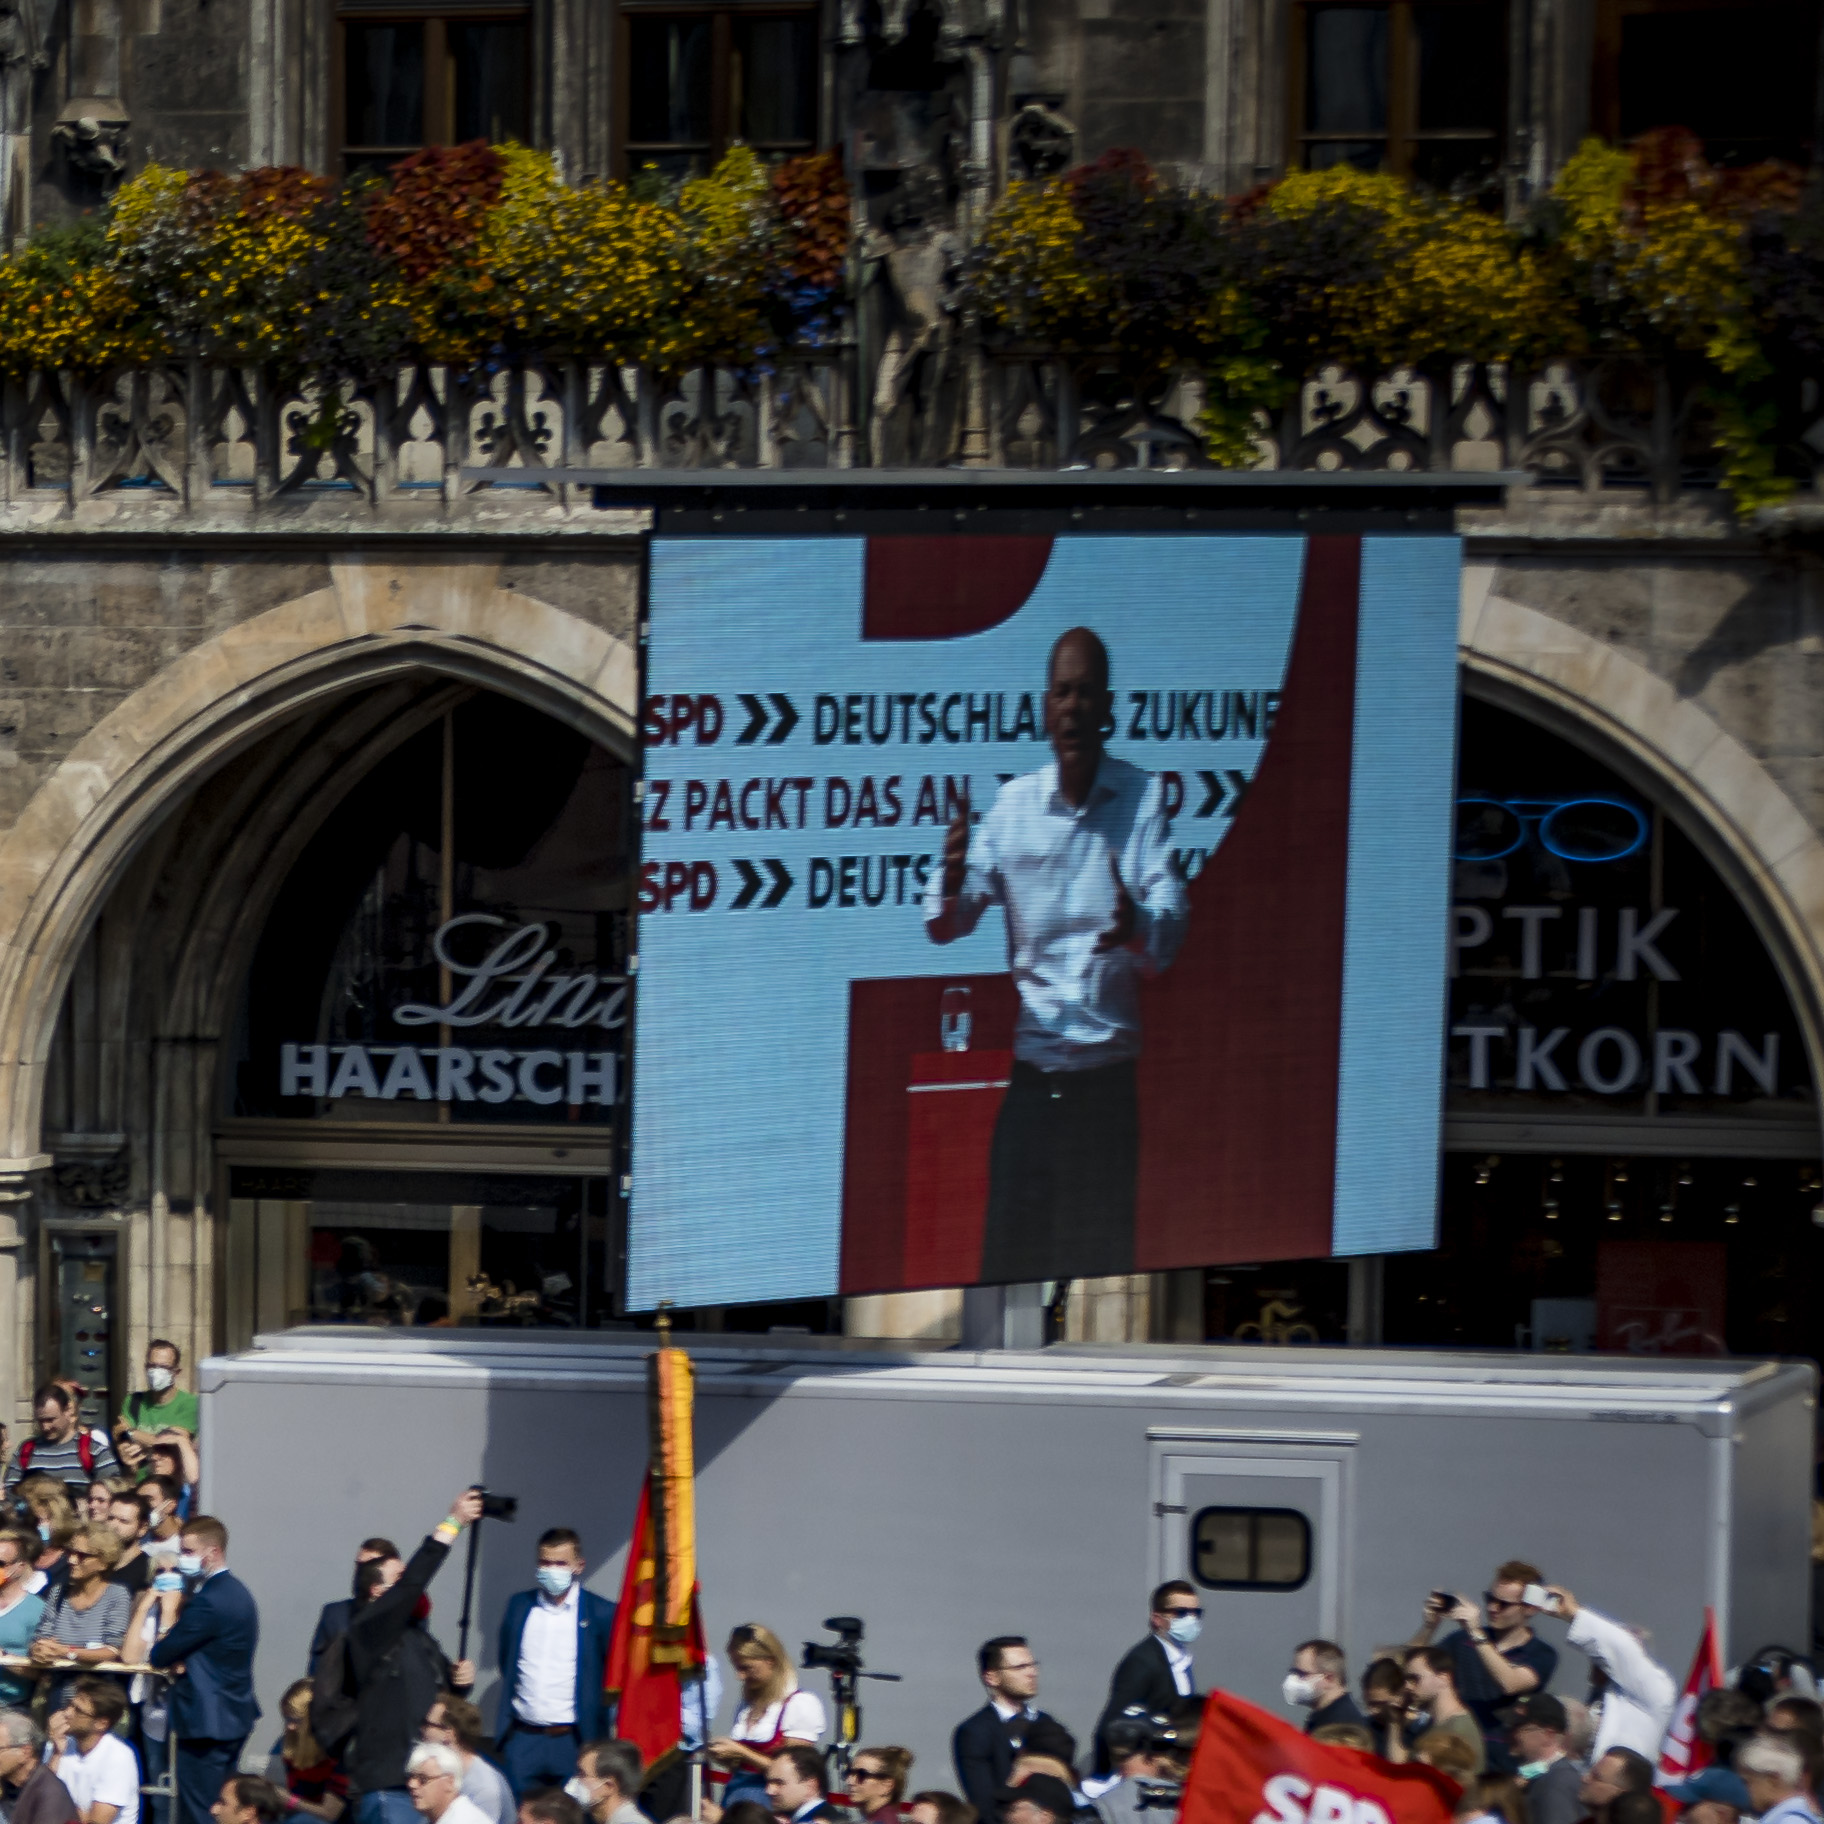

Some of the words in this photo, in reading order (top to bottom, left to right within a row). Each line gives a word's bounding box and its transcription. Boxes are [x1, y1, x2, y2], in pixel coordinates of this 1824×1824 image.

[645, 692, 724, 745] SPD
[685, 776, 813, 831] PACKT
[825, 774, 902, 829] DAS
[639, 859, 718, 913] SPD
[809, 853, 935, 908] DEUTS
